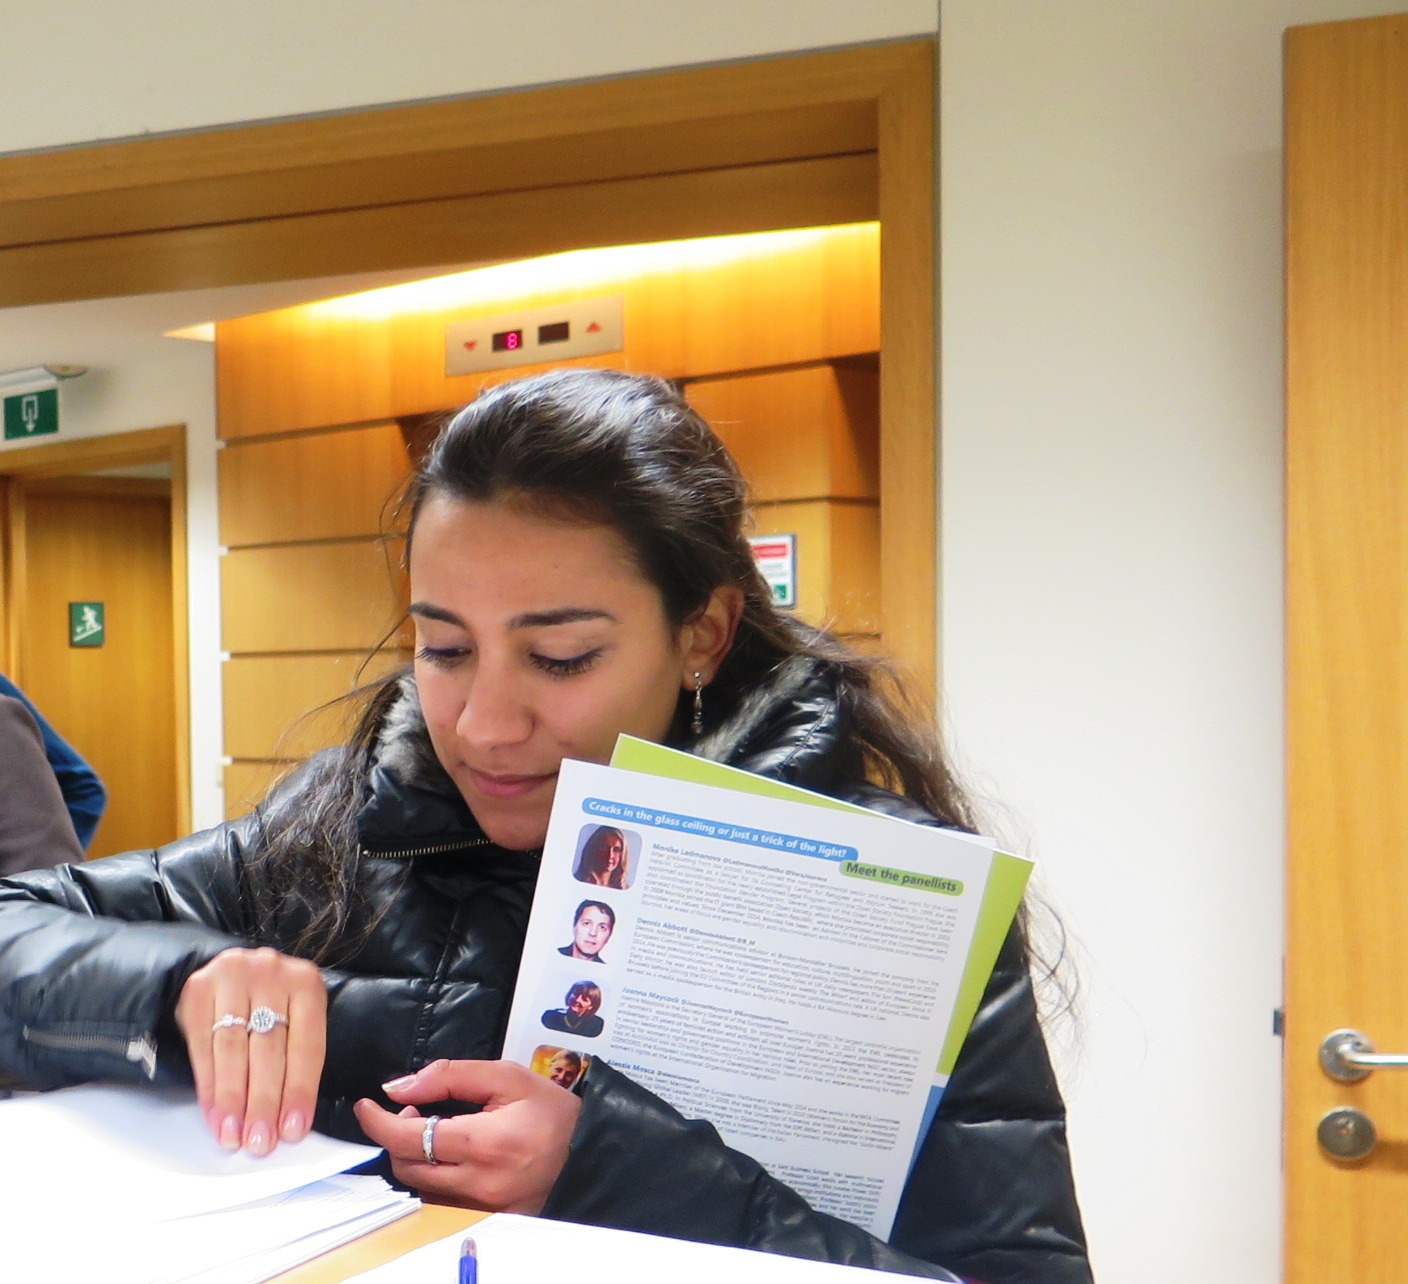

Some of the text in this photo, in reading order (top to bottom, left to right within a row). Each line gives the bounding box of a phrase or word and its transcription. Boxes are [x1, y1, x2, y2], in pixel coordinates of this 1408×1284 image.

[507, 332, 518, 350] 8
[589, 801, 621, 814] Cracks
[623, 808, 632, 816] in
[635, 810, 652, 820] the
[654, 814, 680, 827] glass
[682, 819, 715, 834] ceiling
[718, 827, 729, 835] or
[730, 828, 750, 841] just
[761, 834, 783, 845] trick
[786, 839, 796, 848] of
[799, 842, 815, 852] the
[818, 845, 846, 860] light?
[652, 843, 678, 852] Monika
[681, 849, 720, 860] Ladmanova
[846, 862, 956, 894] Meet the panellists
[637, 917, 660, 925] Dennis
[662, 922, 687, 931] Abbott
[622, 987, 646, 995] Joanna
[648, 992, 678, 1003] Maycock
[607, 1059, 630, 1068] Alessia
[633, 1064, 654, 1073] Mosca
